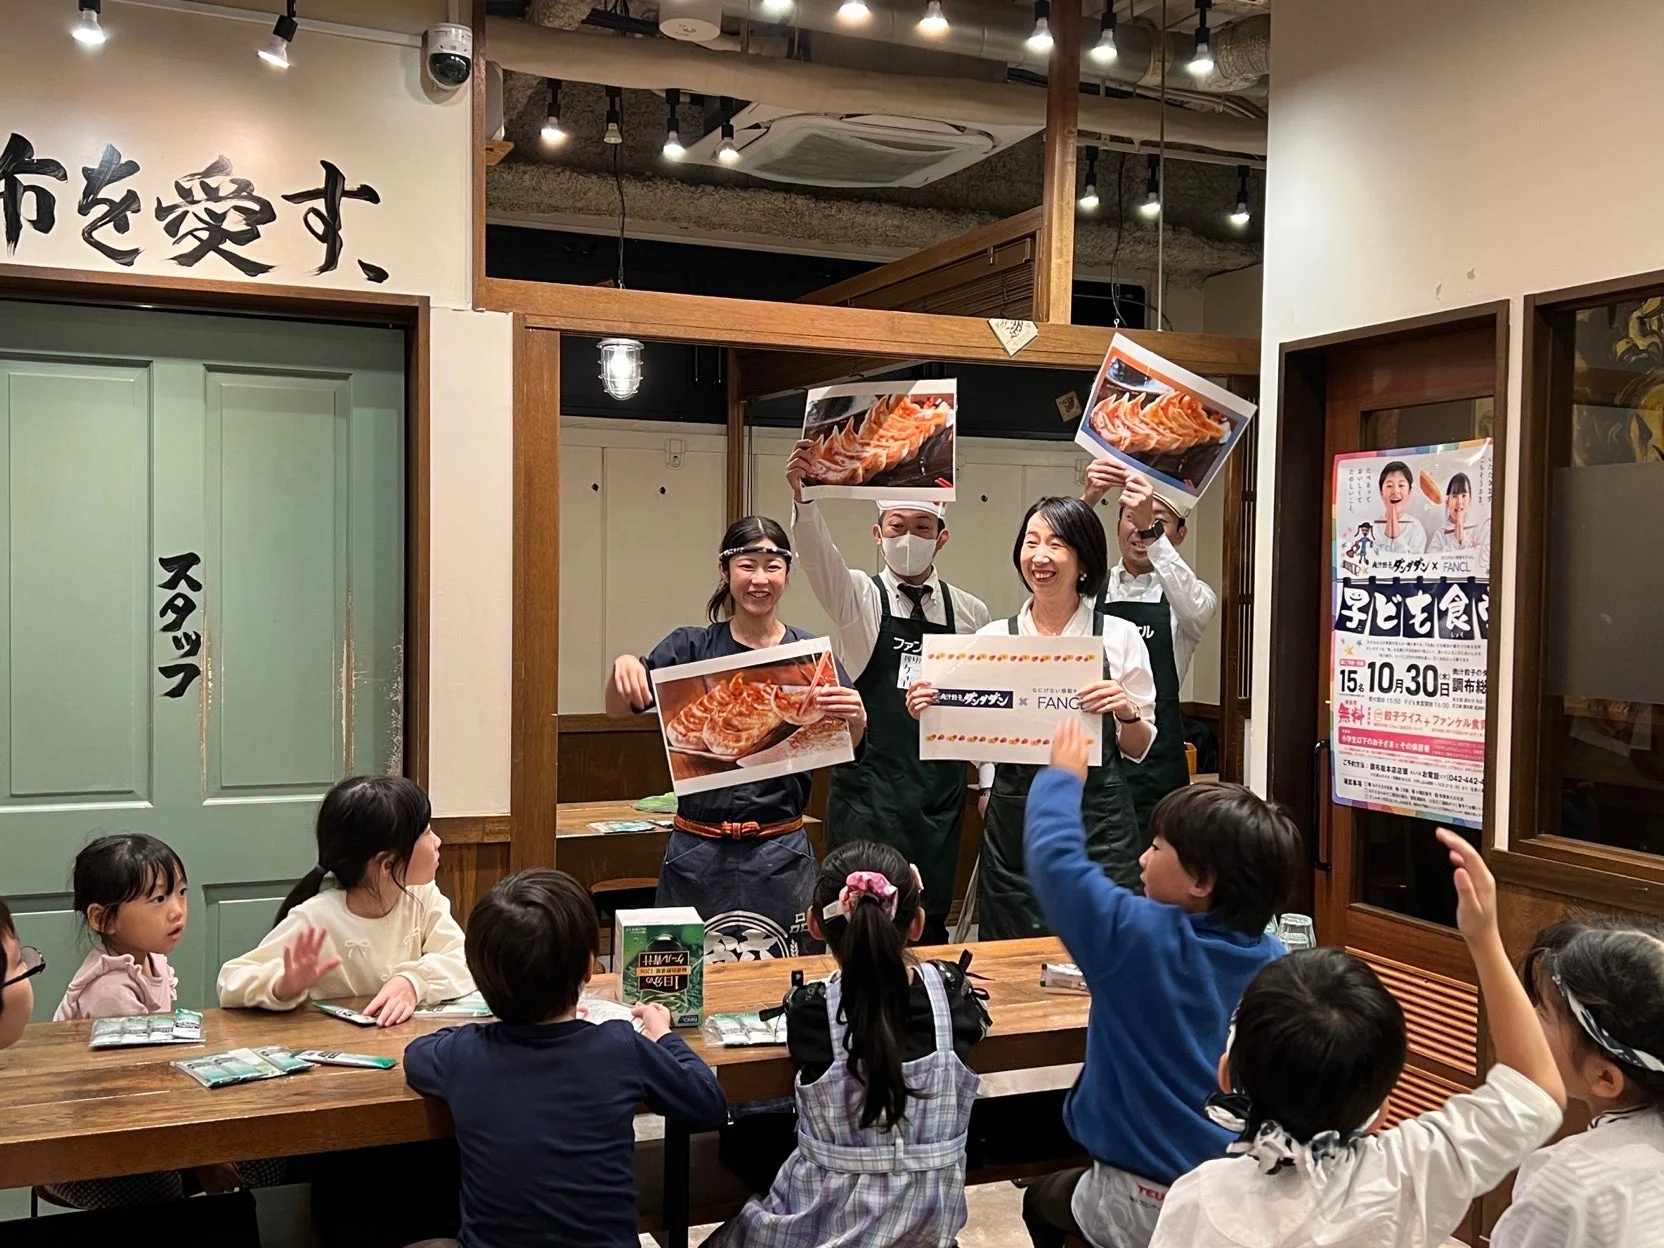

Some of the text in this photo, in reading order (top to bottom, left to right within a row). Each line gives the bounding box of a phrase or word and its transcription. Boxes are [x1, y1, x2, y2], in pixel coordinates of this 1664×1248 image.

[1443, 562, 1471, 573] FANCL
[157, 552, 202, 698] スタッフ
[1338, 702, 1365, 725] 無料
[645, 975, 679, 990] 1日分の
